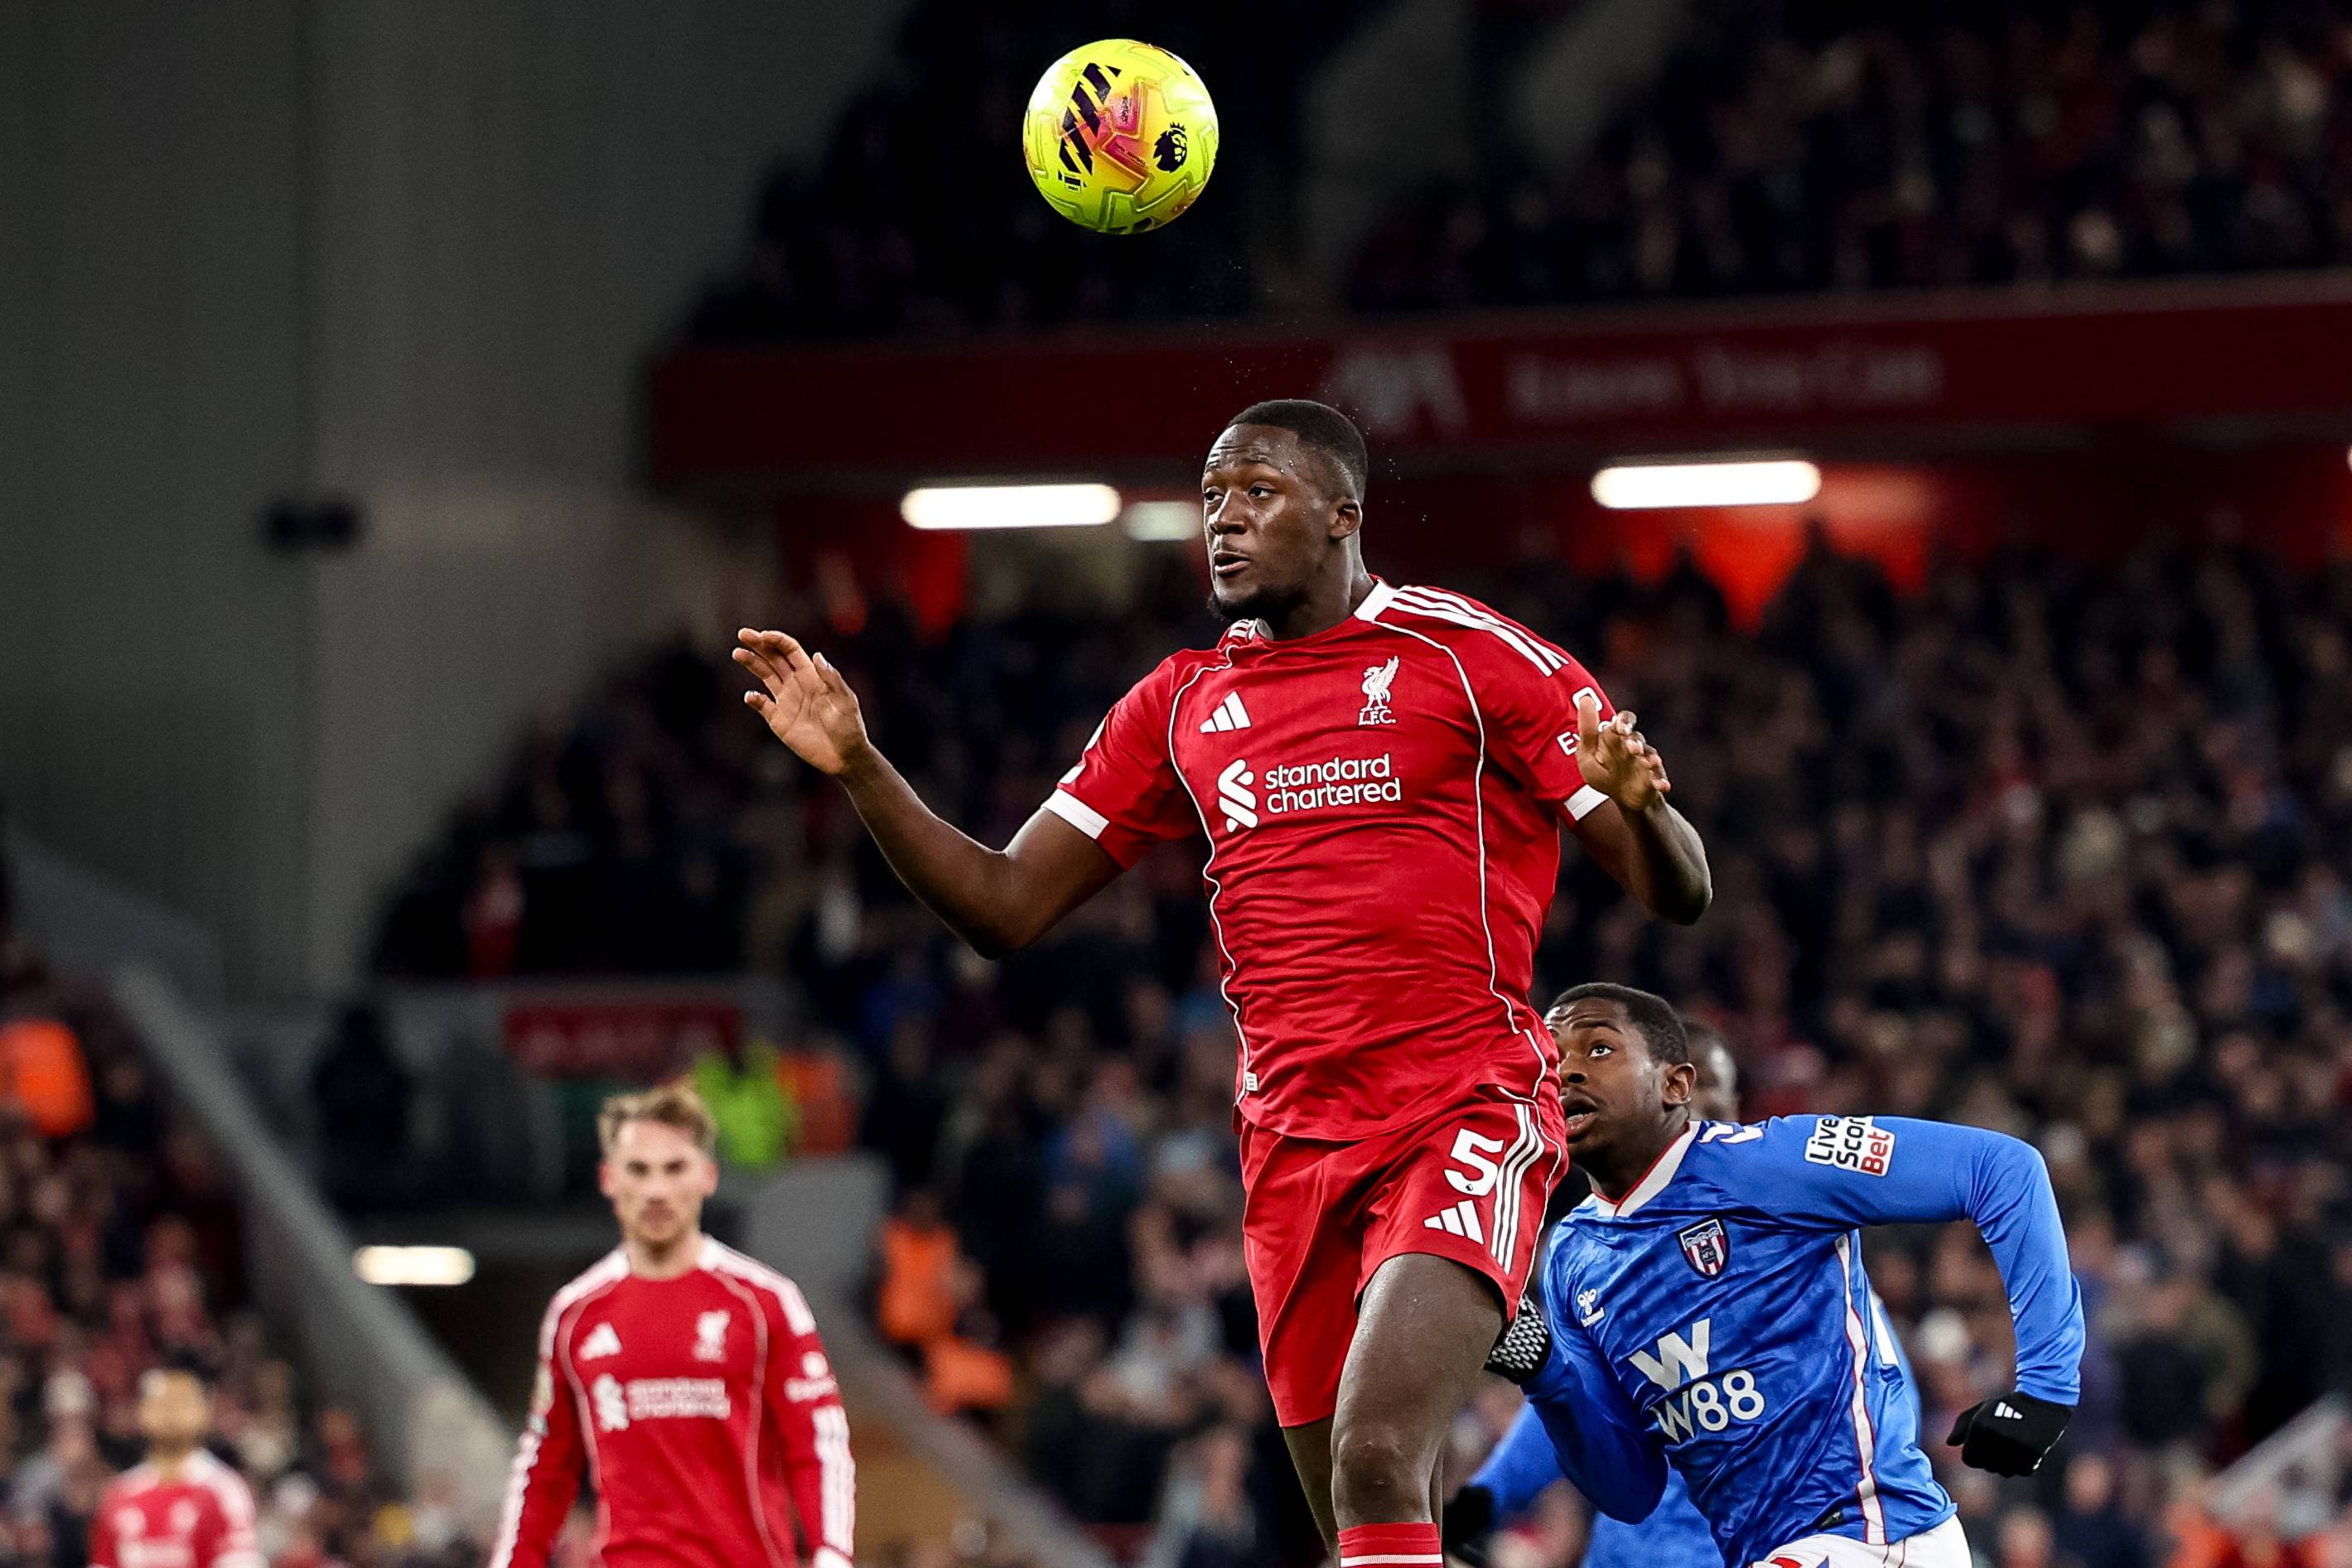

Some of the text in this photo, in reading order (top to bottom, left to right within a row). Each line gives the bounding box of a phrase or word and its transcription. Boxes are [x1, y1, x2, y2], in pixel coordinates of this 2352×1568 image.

[1265, 753, 1391, 789] standard
[1266, 779, 1402, 813] chartered
[1809, 1118, 1839, 1160] Live
[1836, 1118, 1866, 1168] Scor
[1860, 1131, 1891, 1175] Bet
[1444, 1128, 1504, 1196] 5
[1649, 1369, 1765, 1444] W88
